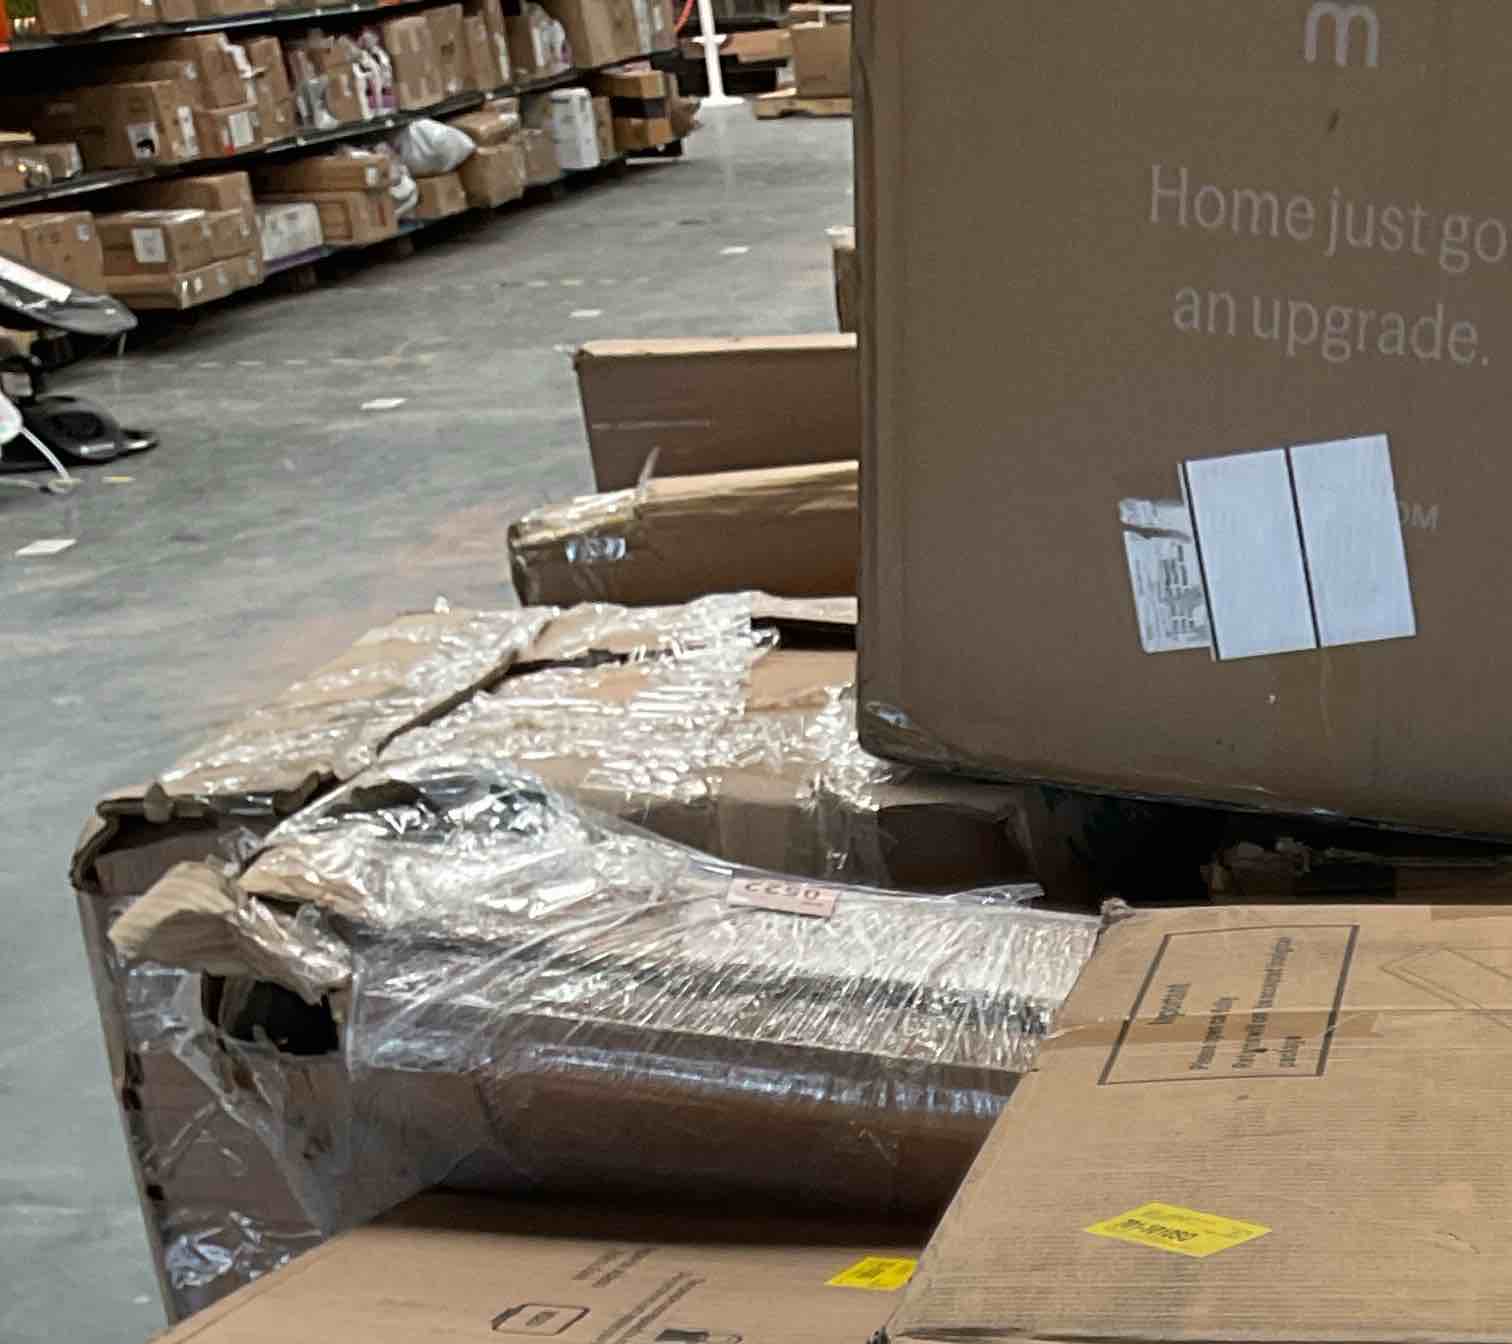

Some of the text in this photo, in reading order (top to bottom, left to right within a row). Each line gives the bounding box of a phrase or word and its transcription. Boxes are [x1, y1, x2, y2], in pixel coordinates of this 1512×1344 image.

[1149, 165, 1315, 240] Home
[1327, 188, 1428, 256] just
[1173, 288, 1489, 366] an upgrade.
